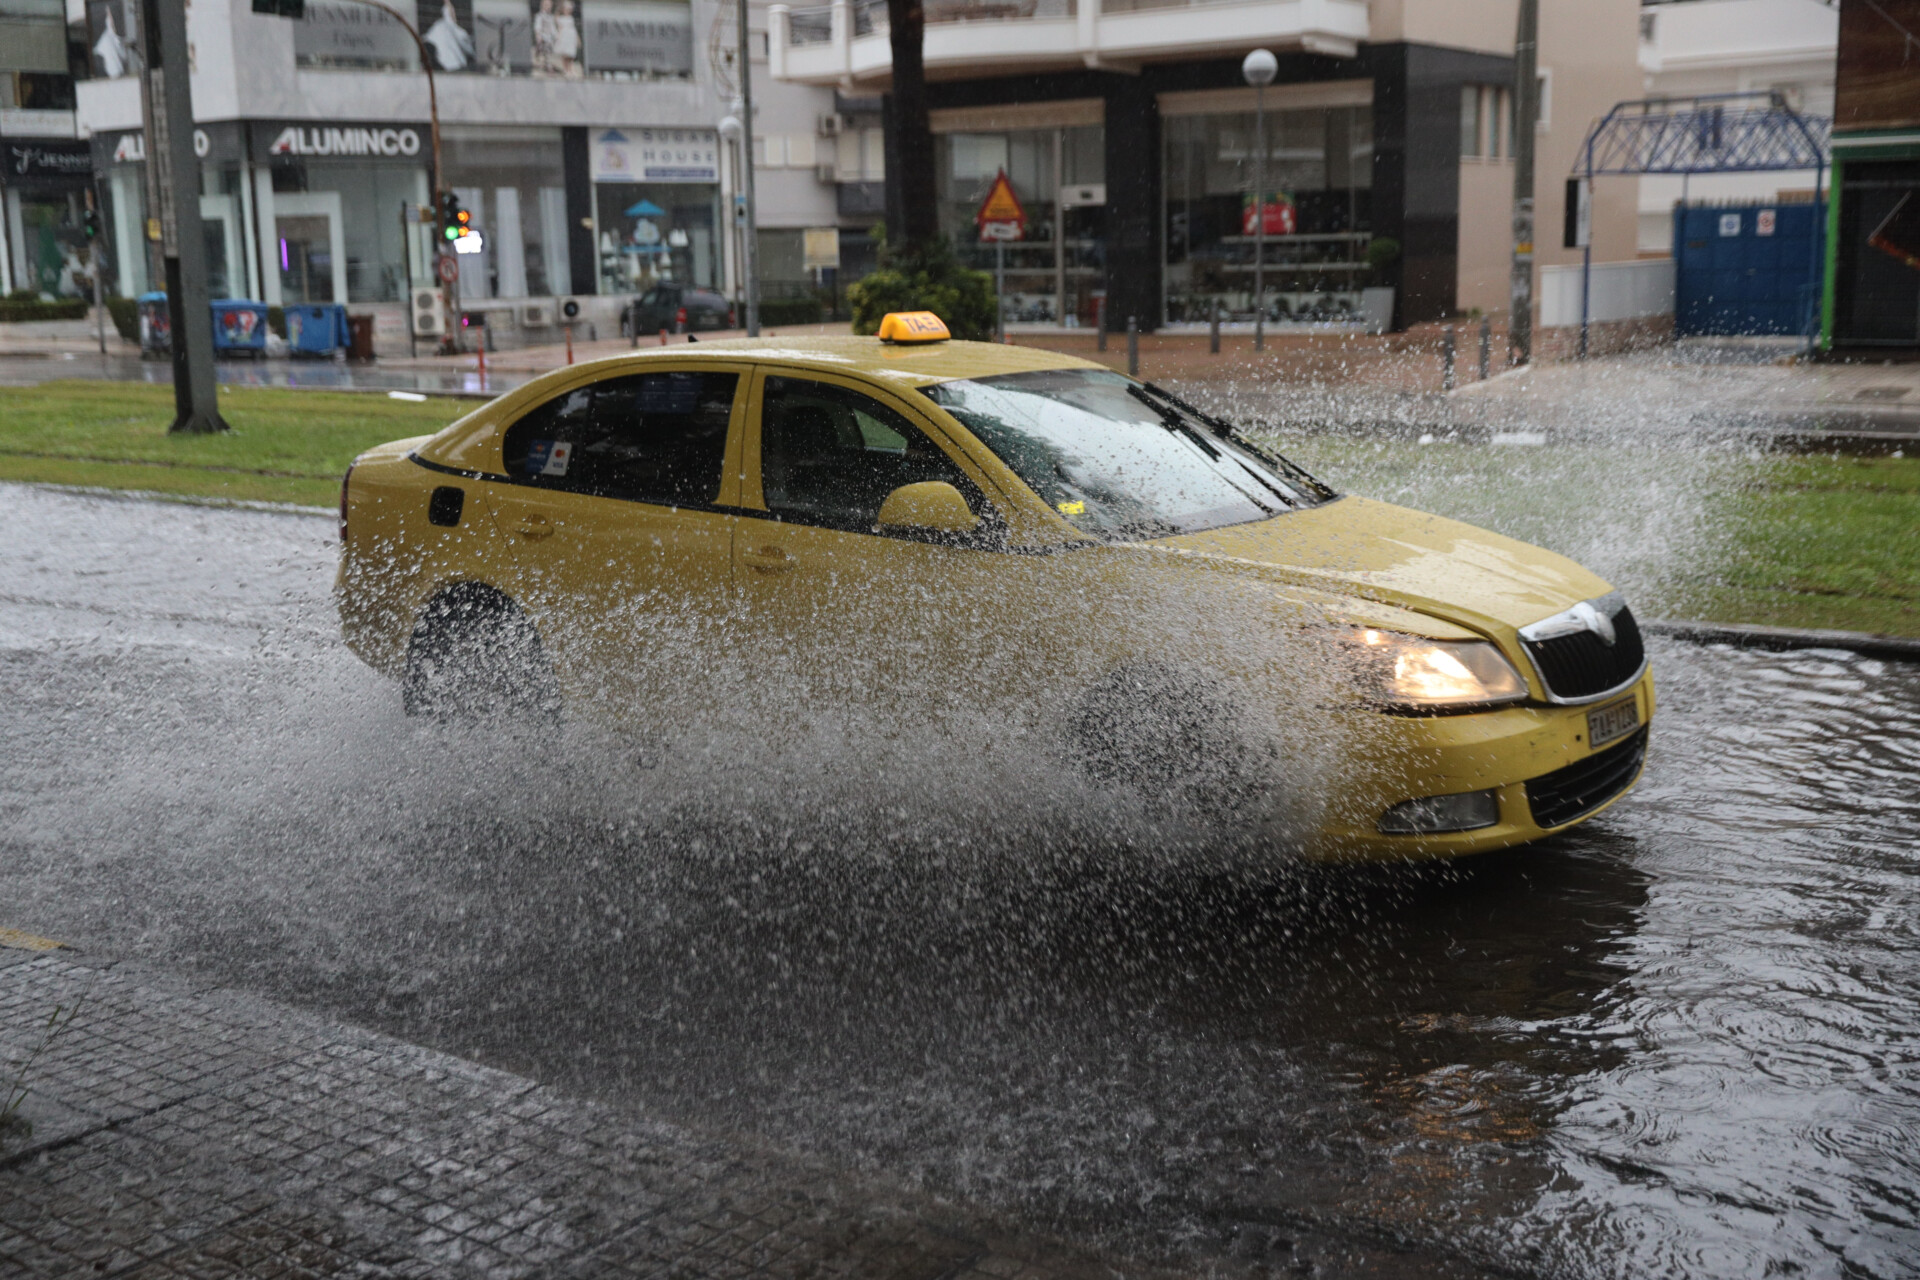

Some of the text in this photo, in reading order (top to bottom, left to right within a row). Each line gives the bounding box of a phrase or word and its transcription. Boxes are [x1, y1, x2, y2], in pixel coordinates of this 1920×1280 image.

[270, 127, 420, 156] ALUMINCO
[642, 128, 713, 143] SUGAR
[643, 147, 714, 163] HOUSE
